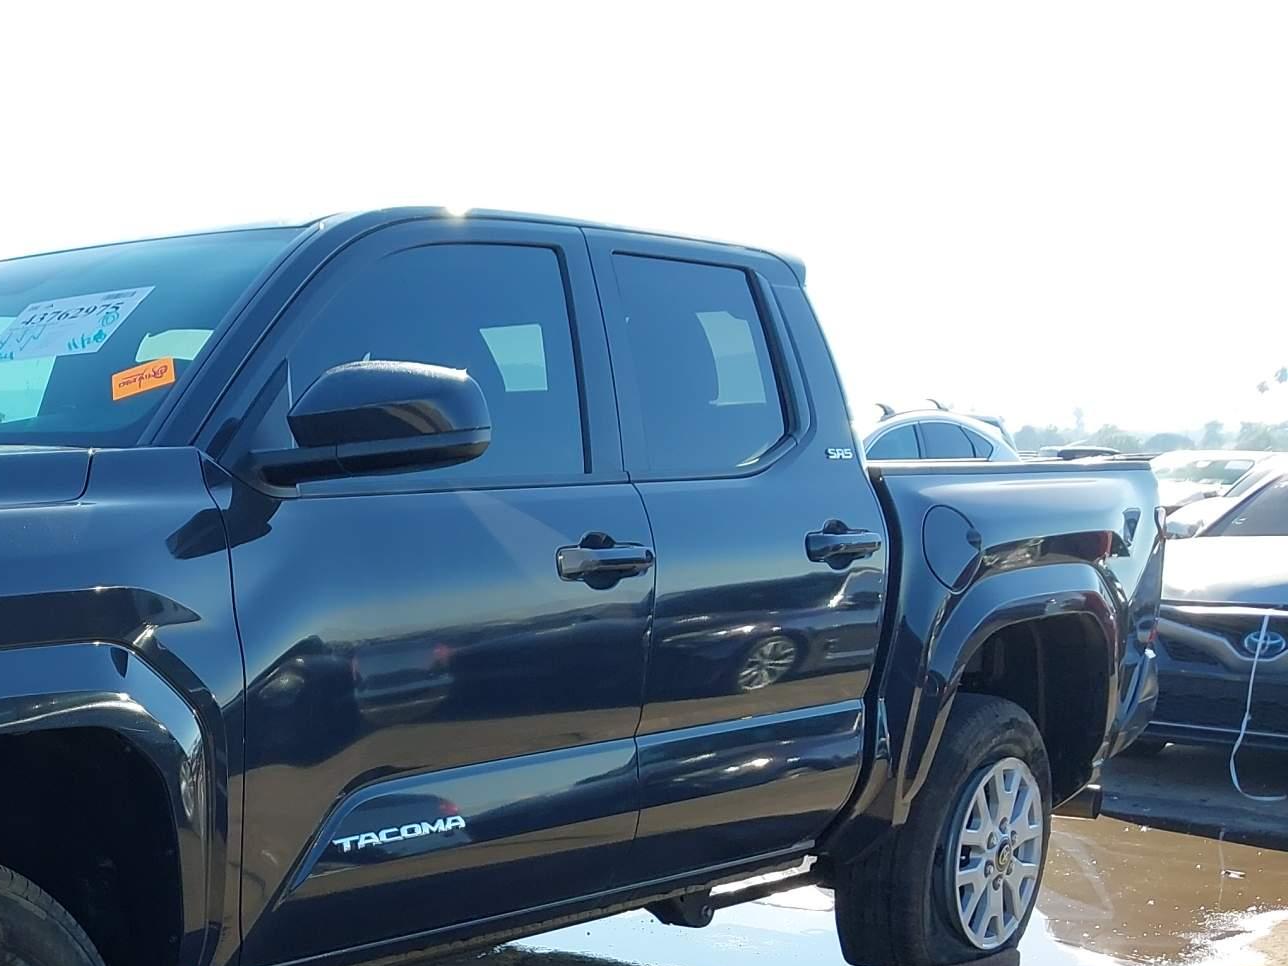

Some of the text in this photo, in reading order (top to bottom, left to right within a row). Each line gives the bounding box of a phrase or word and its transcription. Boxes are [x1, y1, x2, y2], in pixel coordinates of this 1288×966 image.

[21, 301, 124, 326] 43762975
[825, 447, 853, 459] SR5
[332, 815, 466, 852] TACOMA
